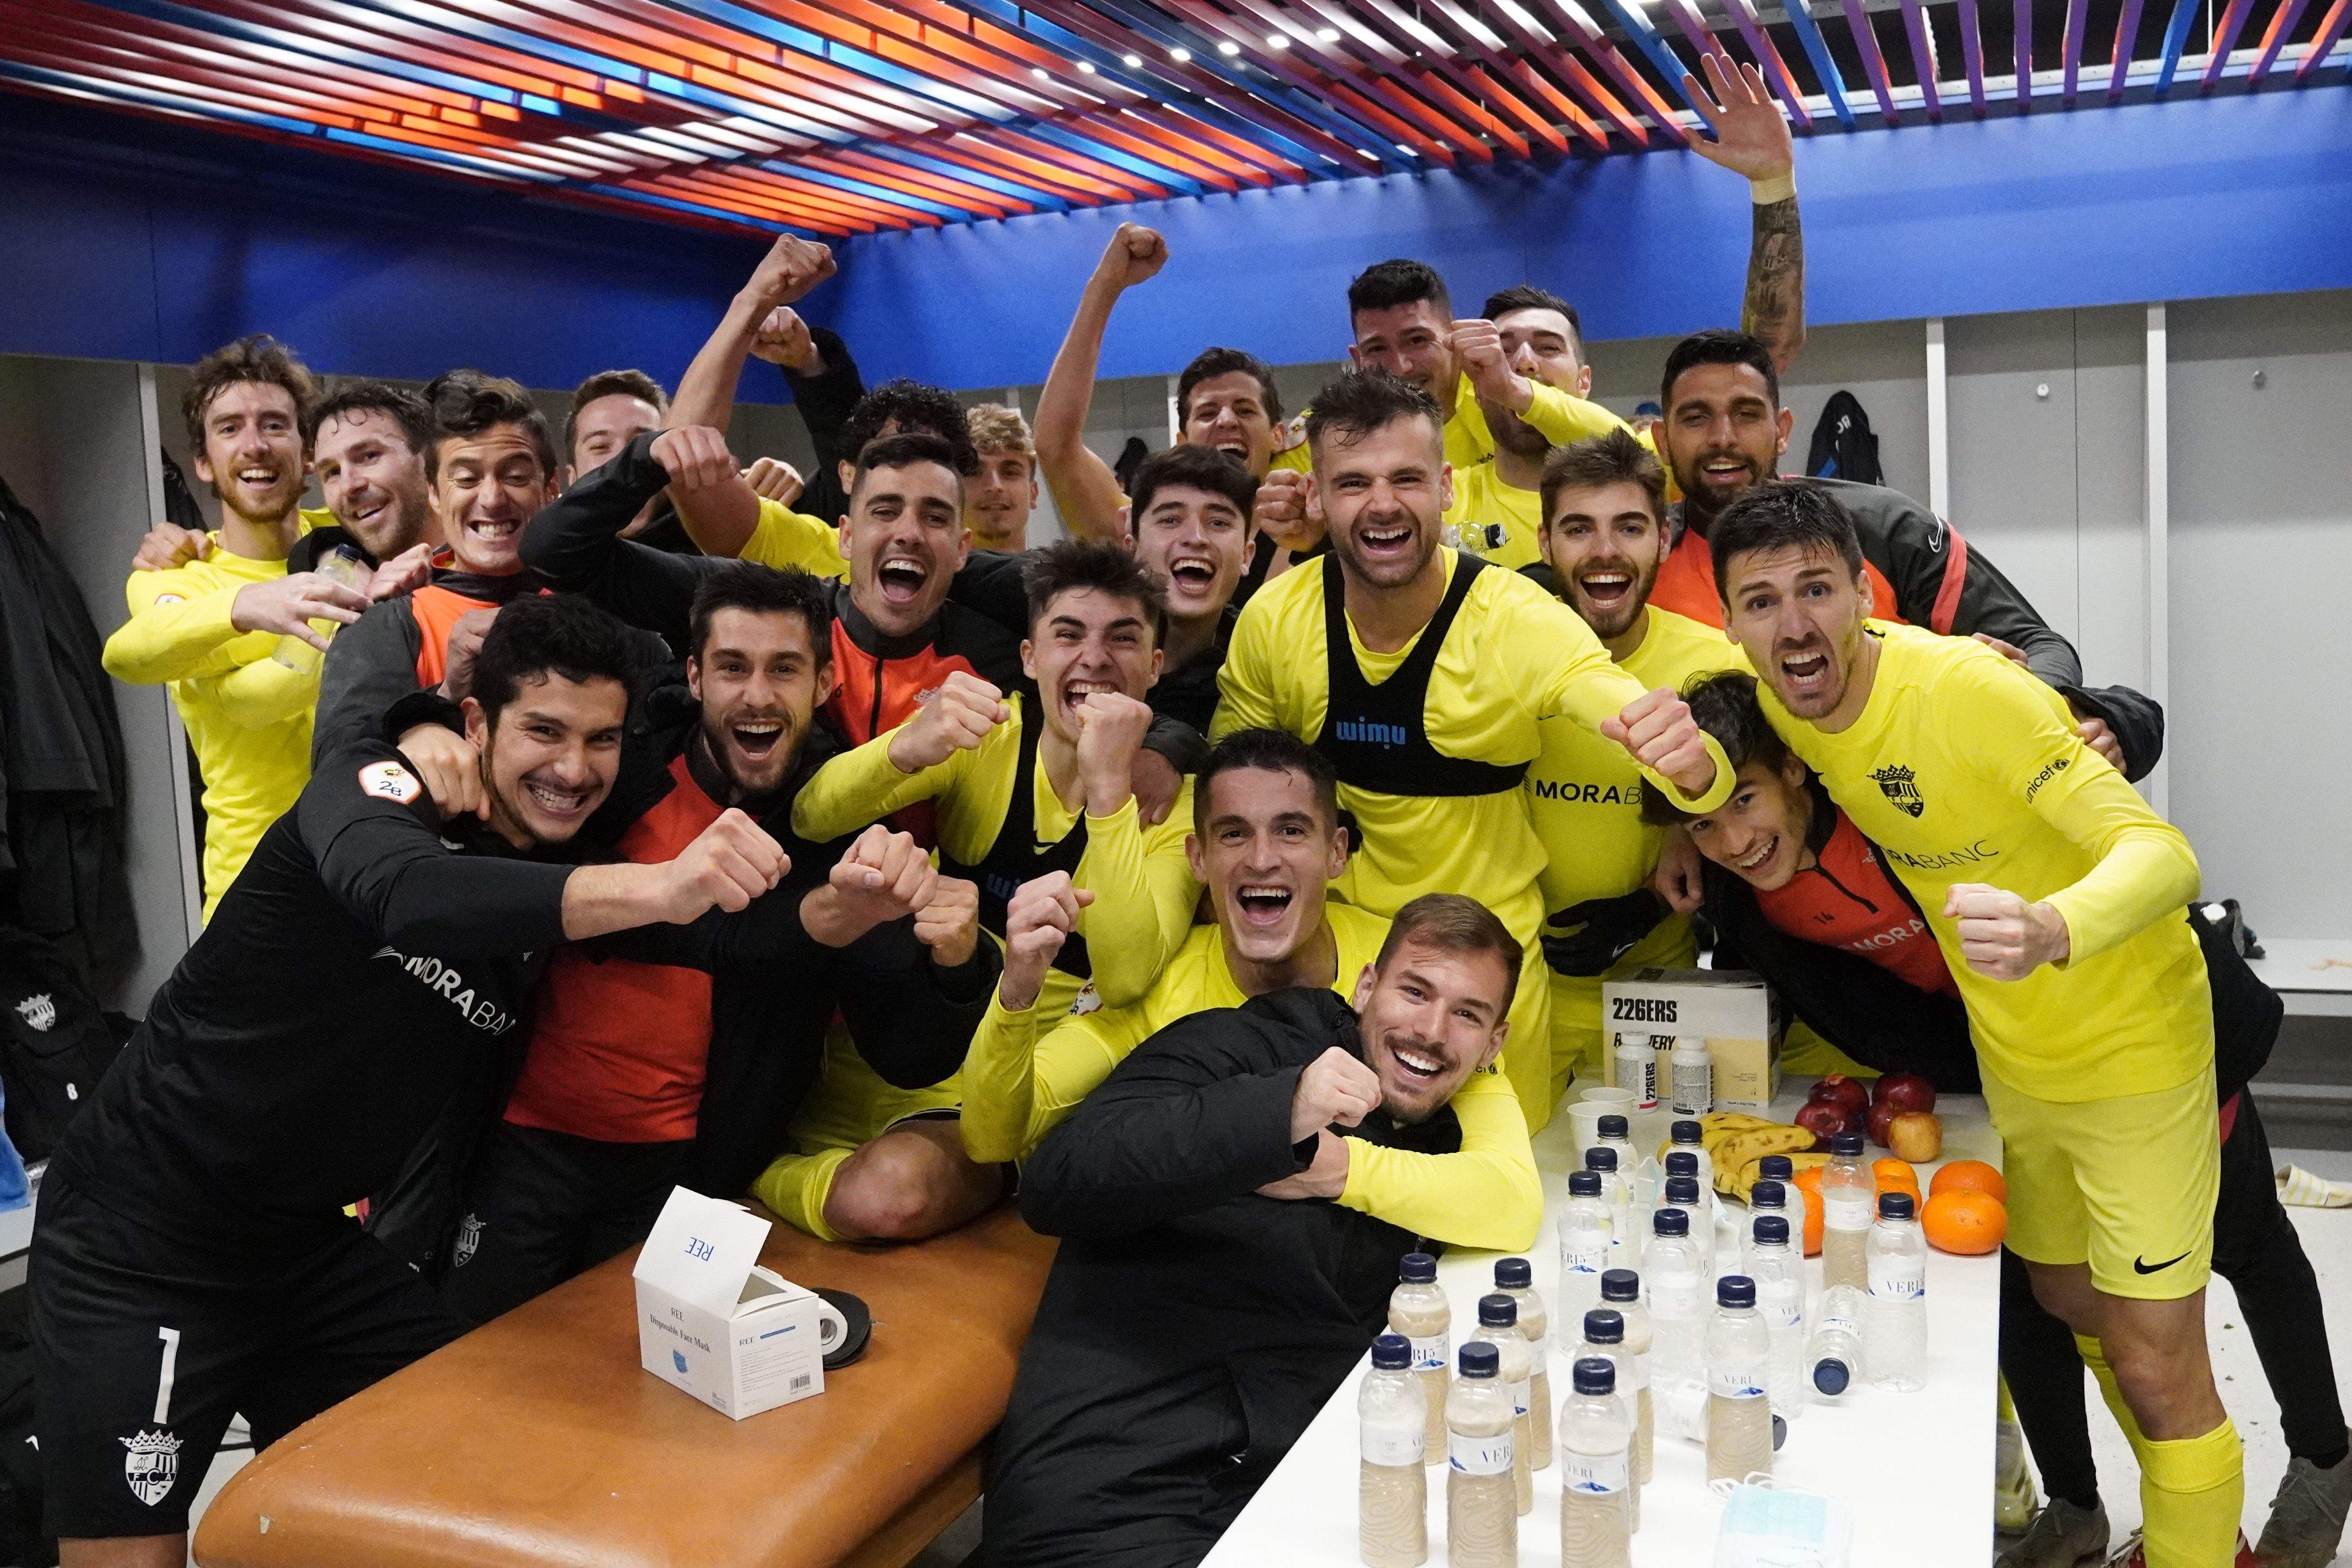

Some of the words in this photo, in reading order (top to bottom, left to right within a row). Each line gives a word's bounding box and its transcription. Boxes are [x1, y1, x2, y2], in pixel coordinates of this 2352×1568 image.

[2026, 765, 2055, 804] unicef
[1880, 839, 1999, 869] RABANC
[1613, 997, 1677, 1023] 226ERS
[1646, 1062, 1655, 1100] 226ERS
[685, 1237, 714, 1262] REE
[671, 1308, 685, 1321] REE
[650, 1314, 678, 1337] Disposable
[680, 1330, 693, 1343] Face
[694, 1336, 711, 1353] Mask
[740, 1336, 755, 1346] REE
[153, 1326, 181, 1424] 1
